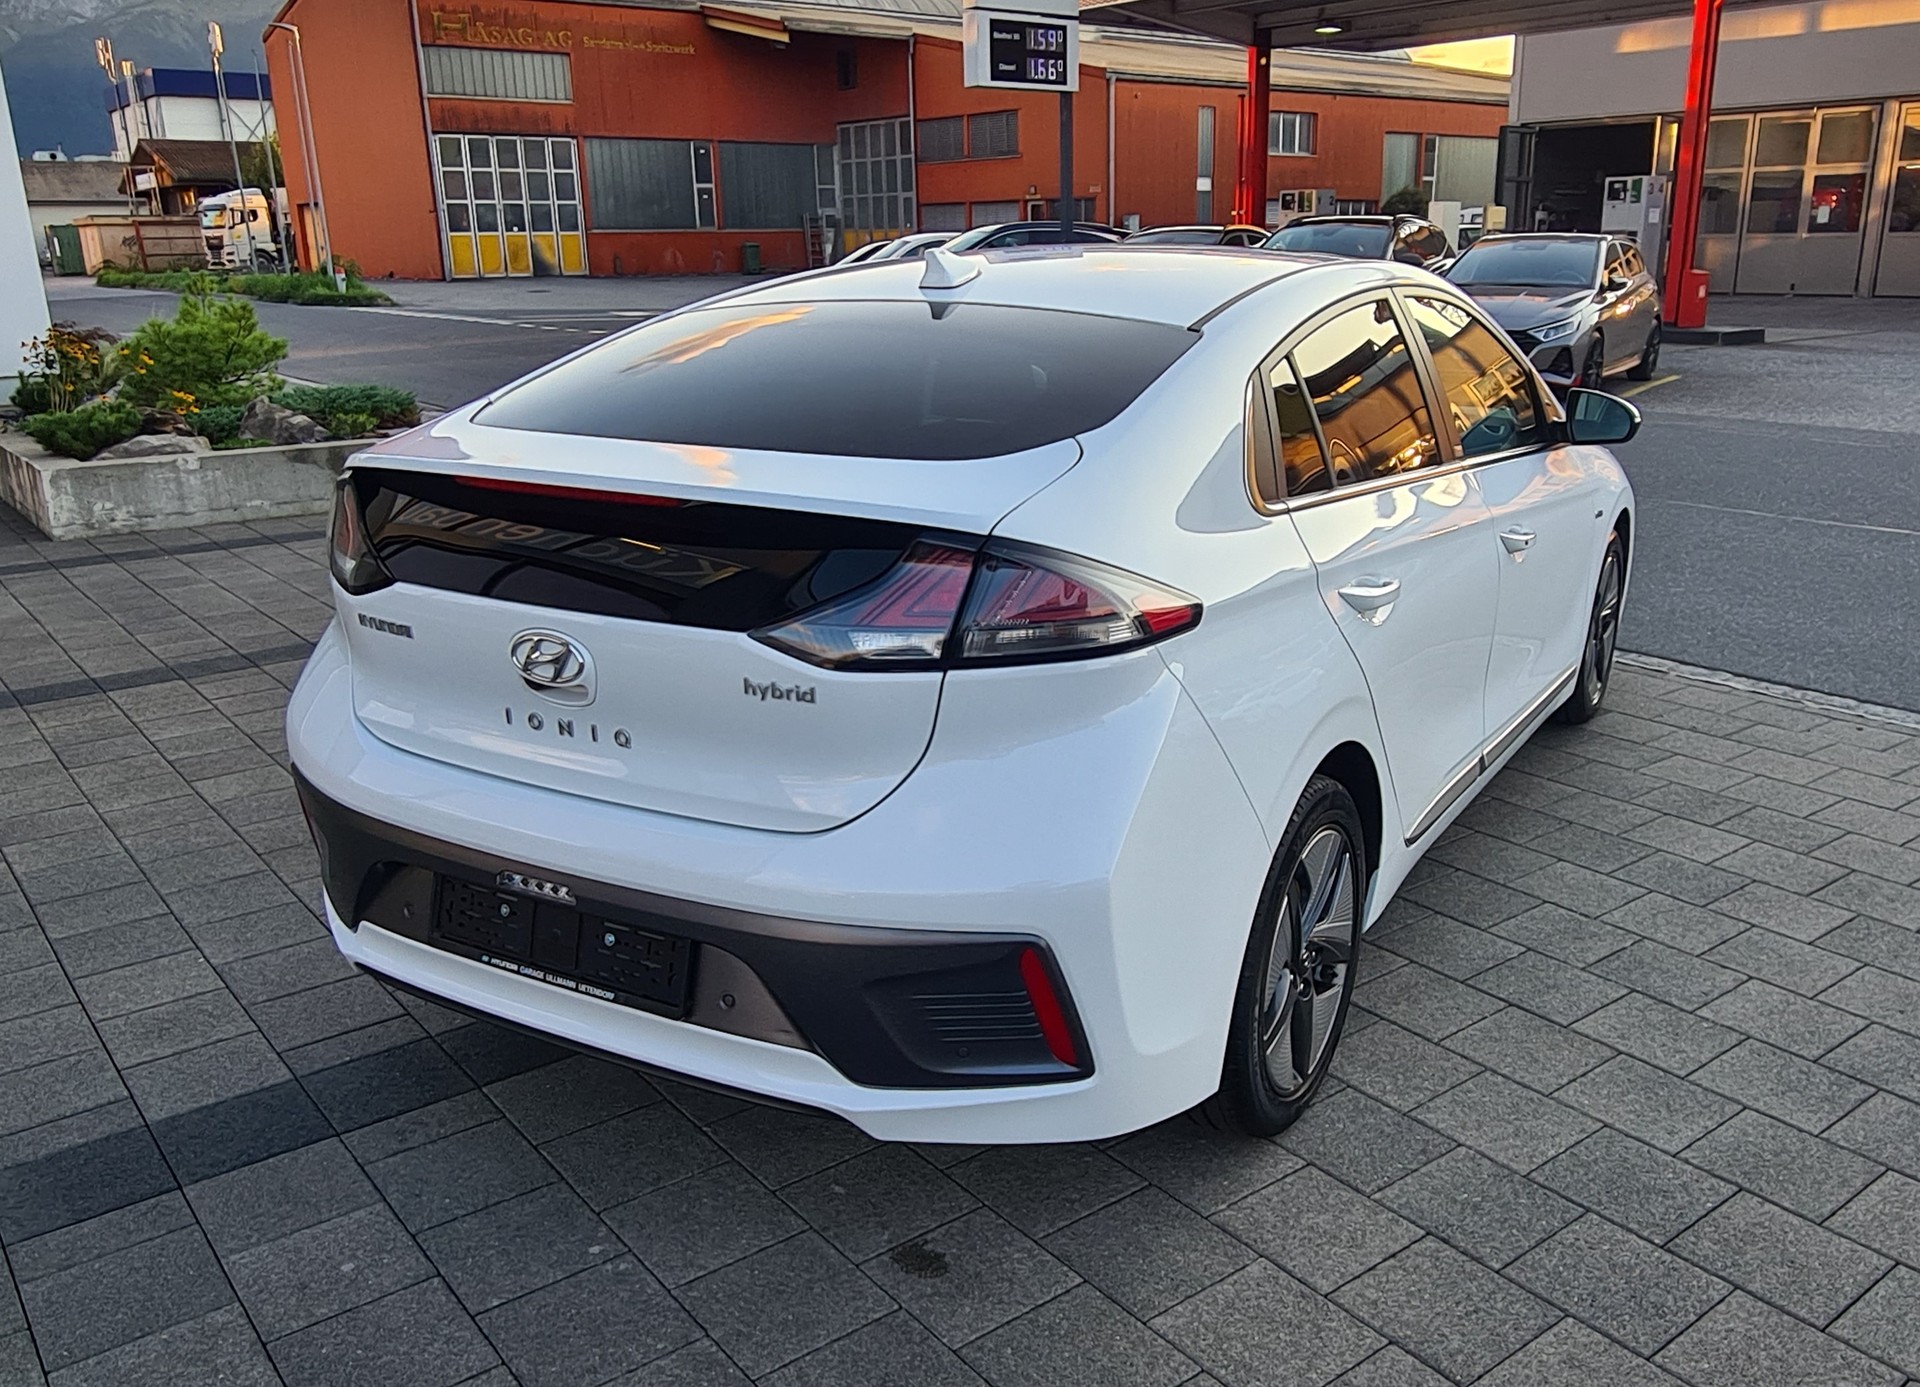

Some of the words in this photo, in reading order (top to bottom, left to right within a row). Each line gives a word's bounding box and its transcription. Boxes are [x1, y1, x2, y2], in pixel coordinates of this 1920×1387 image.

[543, 30, 573, 48] AG
[1647, 182, 1655, 195] 3
[743, 676, 817, 704] hybrid
[505, 707, 632, 749] IONIQ
[519, 965, 545, 979] GARAGE
[545, 973, 577, 989] ULLMANN
